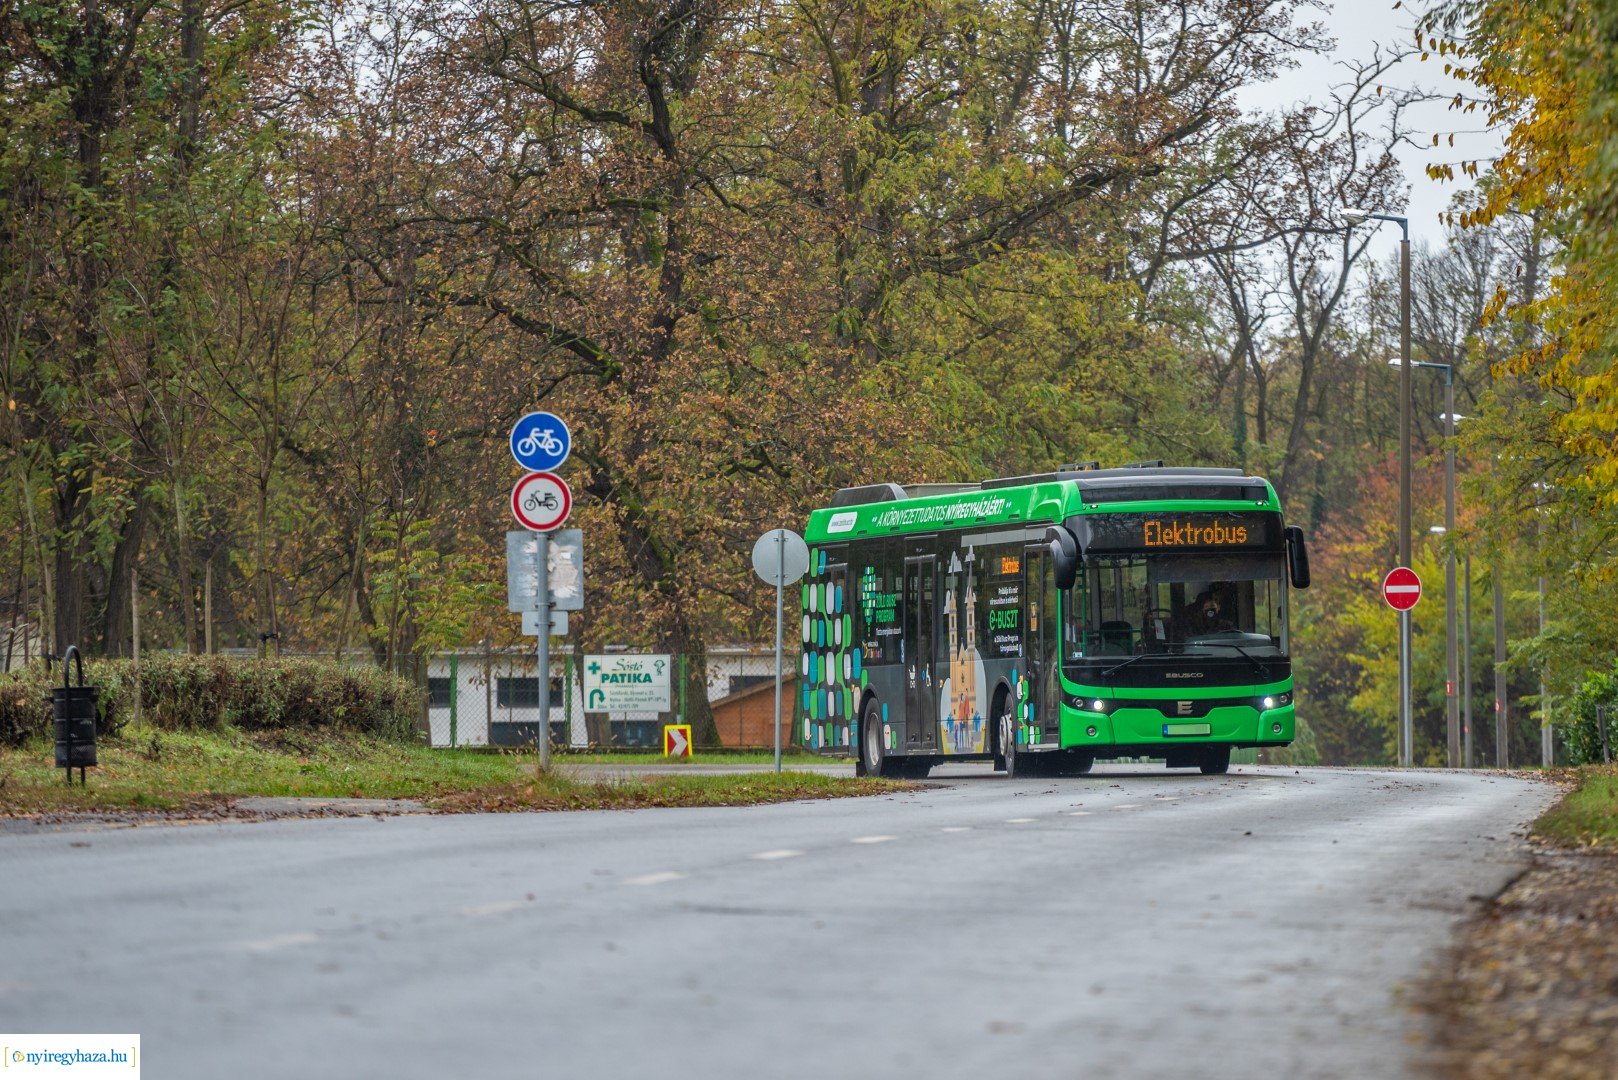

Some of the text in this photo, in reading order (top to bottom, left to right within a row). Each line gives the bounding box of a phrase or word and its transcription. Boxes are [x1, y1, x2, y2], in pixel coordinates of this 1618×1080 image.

[882, 505, 947, 527] KÖRNYEZETTUDATOS
[1144, 520, 1247, 546] Elektrobus
[612, 658, 643, 671] Sóstó
[601, 673, 653, 683] PATIKA
